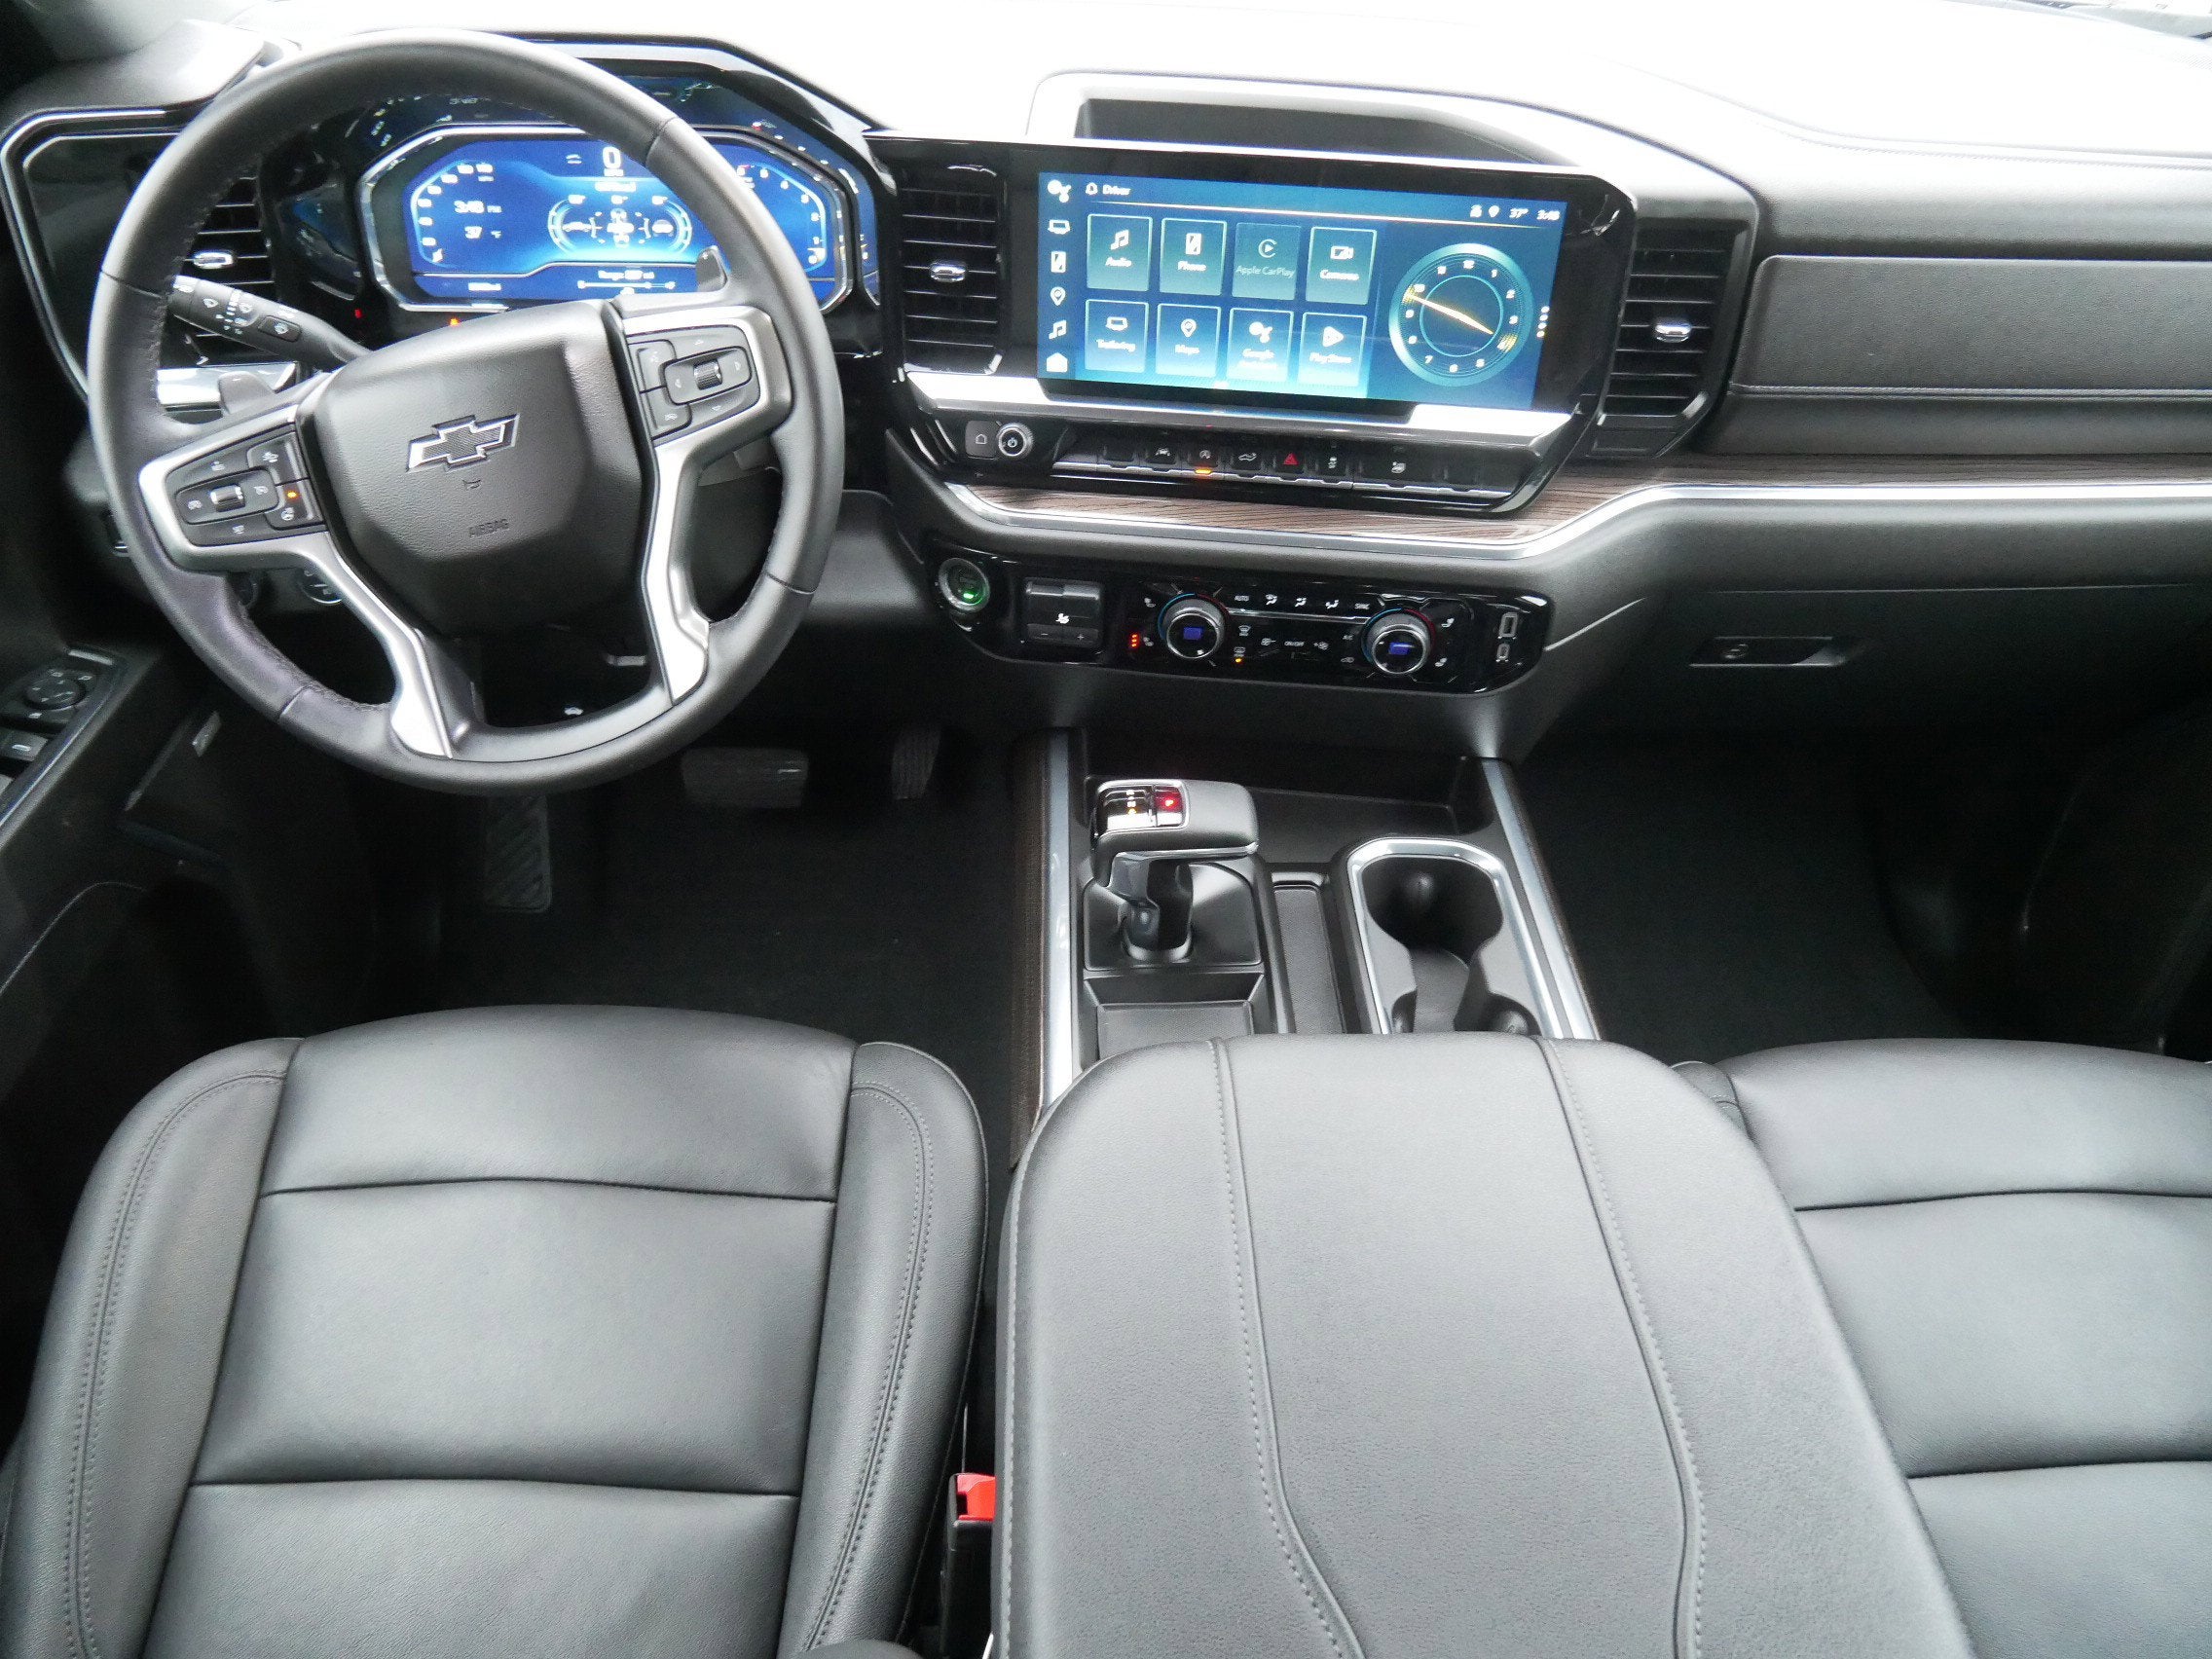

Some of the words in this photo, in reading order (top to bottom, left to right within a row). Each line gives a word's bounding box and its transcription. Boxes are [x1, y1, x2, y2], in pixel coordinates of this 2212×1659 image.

[602, 146, 622, 169] 0
[1104, 256, 1132, 268] Audio
[1177, 260, 1207, 272] Phone
[1235, 265, 1261, 277] Apple
[1262, 266, 1296, 279] CarPlay
